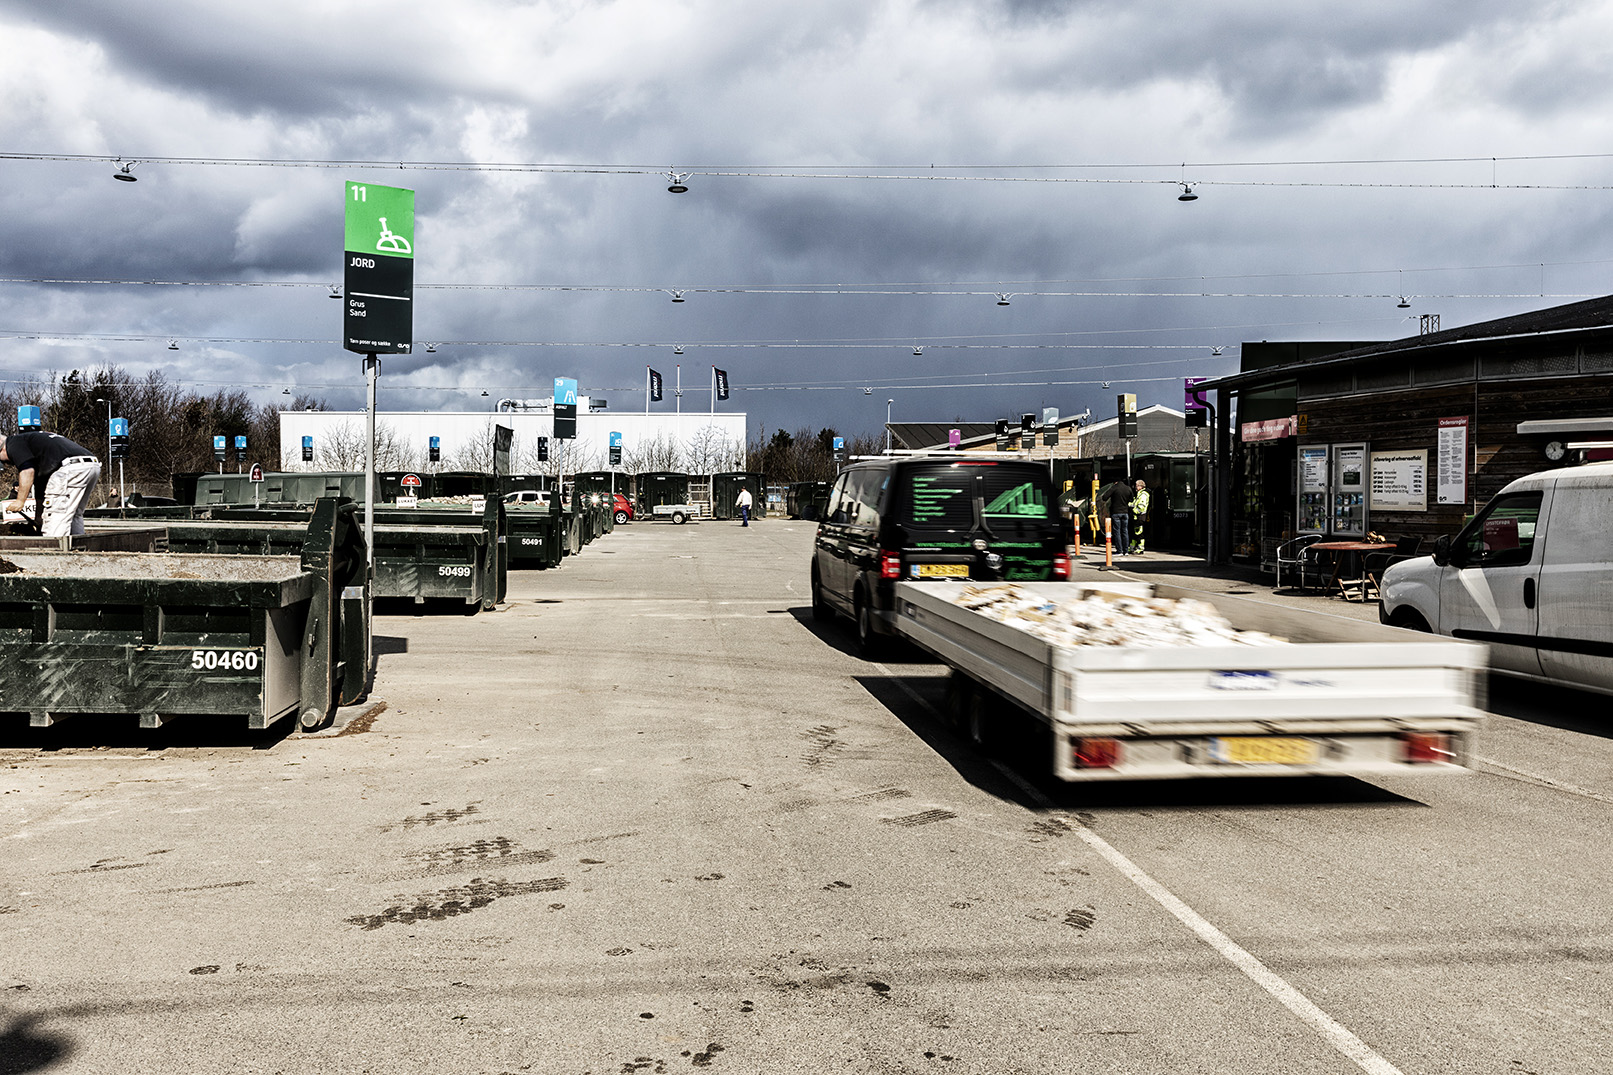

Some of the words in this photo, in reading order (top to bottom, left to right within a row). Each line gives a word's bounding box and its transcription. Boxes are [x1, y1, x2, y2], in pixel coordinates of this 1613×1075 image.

[351, 185, 366, 202] 11
[350, 257, 375, 268] JORD
[350, 299, 365, 308] Grus
[350, 308, 366, 317] Sand
[521, 538, 543, 546] 50491
[438, 566, 471, 577] 50499
[191, 650, 258, 670] 50460
